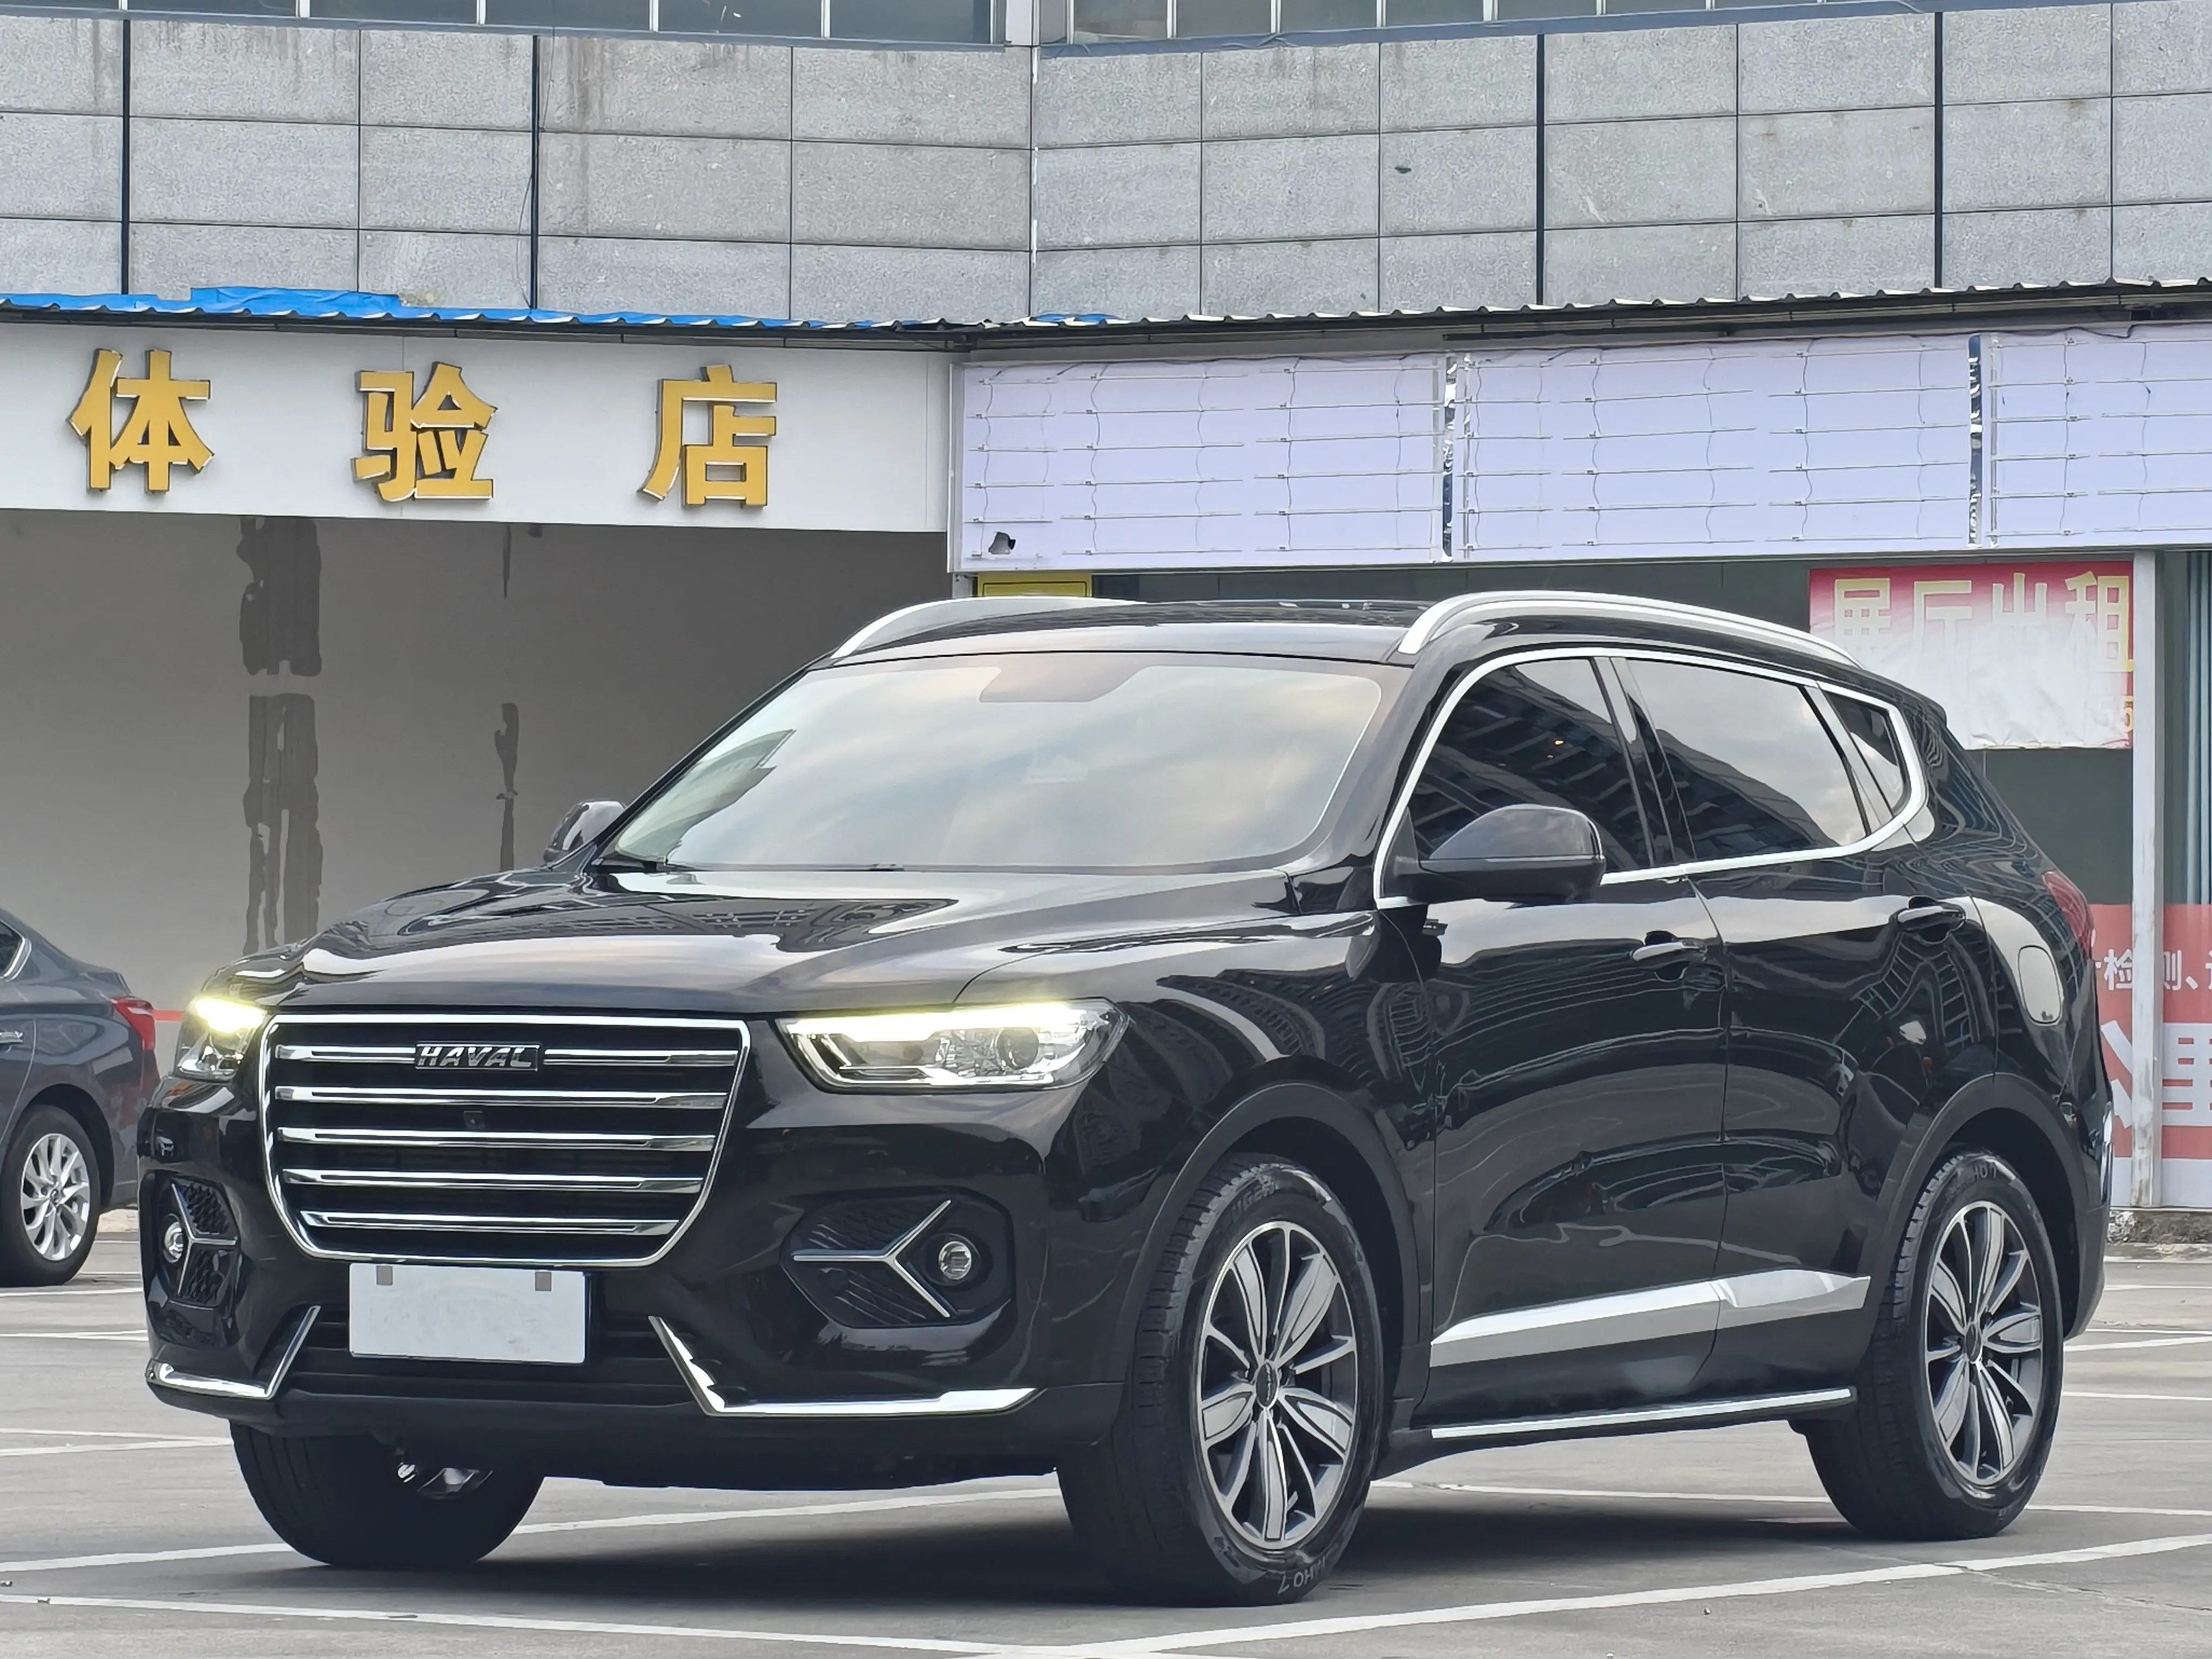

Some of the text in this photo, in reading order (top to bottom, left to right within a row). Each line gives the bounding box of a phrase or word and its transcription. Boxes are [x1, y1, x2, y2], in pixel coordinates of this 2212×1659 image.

[66, 348, 777, 509] 体验店
[417, 1046, 532, 1068] HAVAL
